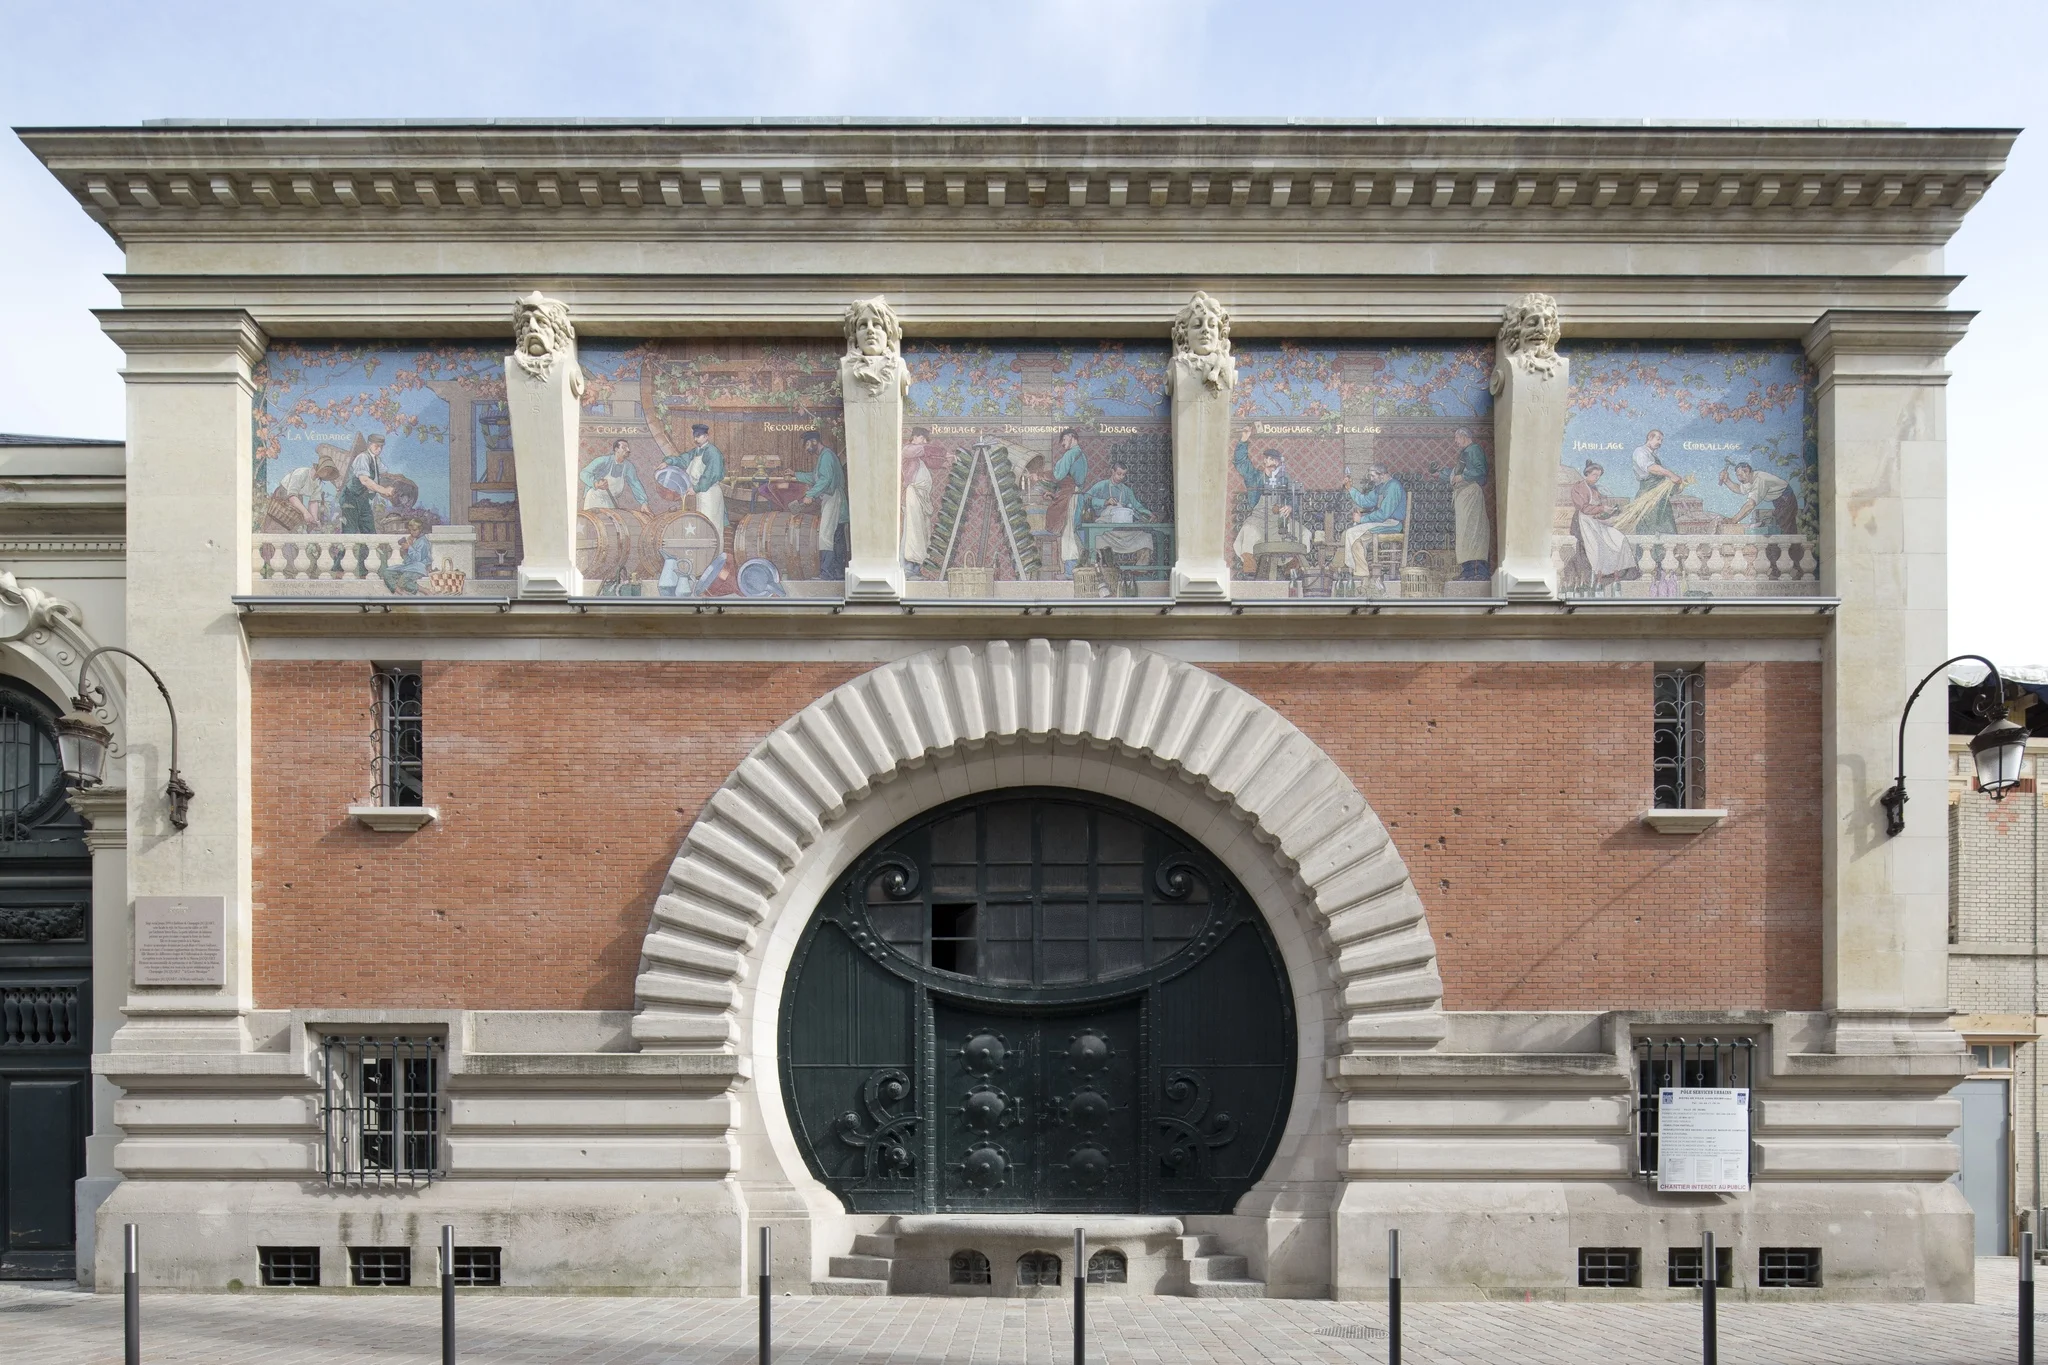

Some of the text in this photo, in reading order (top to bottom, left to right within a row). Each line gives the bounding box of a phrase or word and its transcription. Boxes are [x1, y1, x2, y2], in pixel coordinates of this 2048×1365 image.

[931, 424, 976, 434] REMUAGE
[1099, 424, 1138, 434] DOSAGE
[1335, 424, 1381, 434] FICELAGE
[1572, 440, 1624, 451] HABILLAGE
